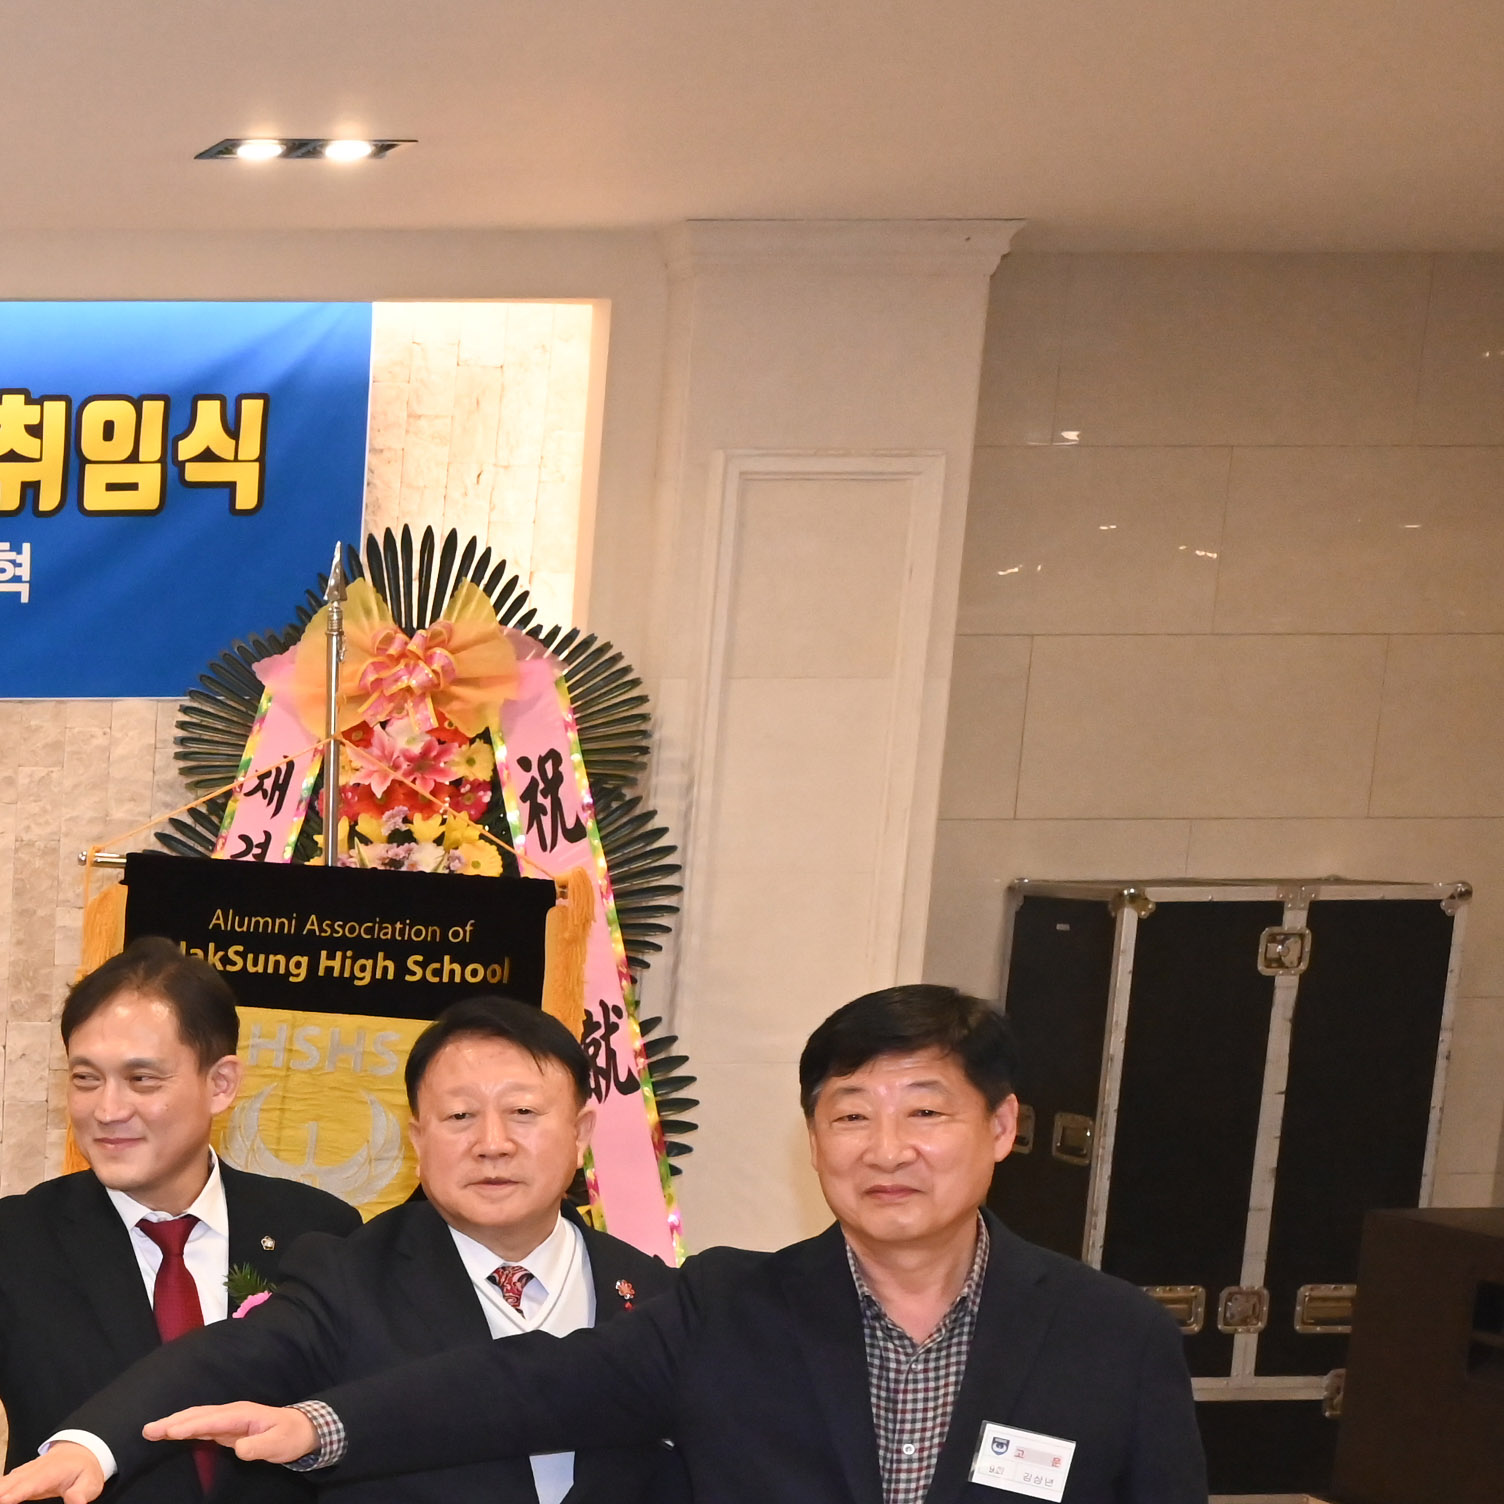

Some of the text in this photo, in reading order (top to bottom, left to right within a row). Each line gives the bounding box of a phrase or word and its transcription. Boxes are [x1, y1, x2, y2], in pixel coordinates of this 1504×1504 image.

[209, 908, 476, 943] Alumni Association of
[317, 950, 395, 986] High
[404, 955, 510, 984] School
[248, 1022, 402, 1076] HSHS
